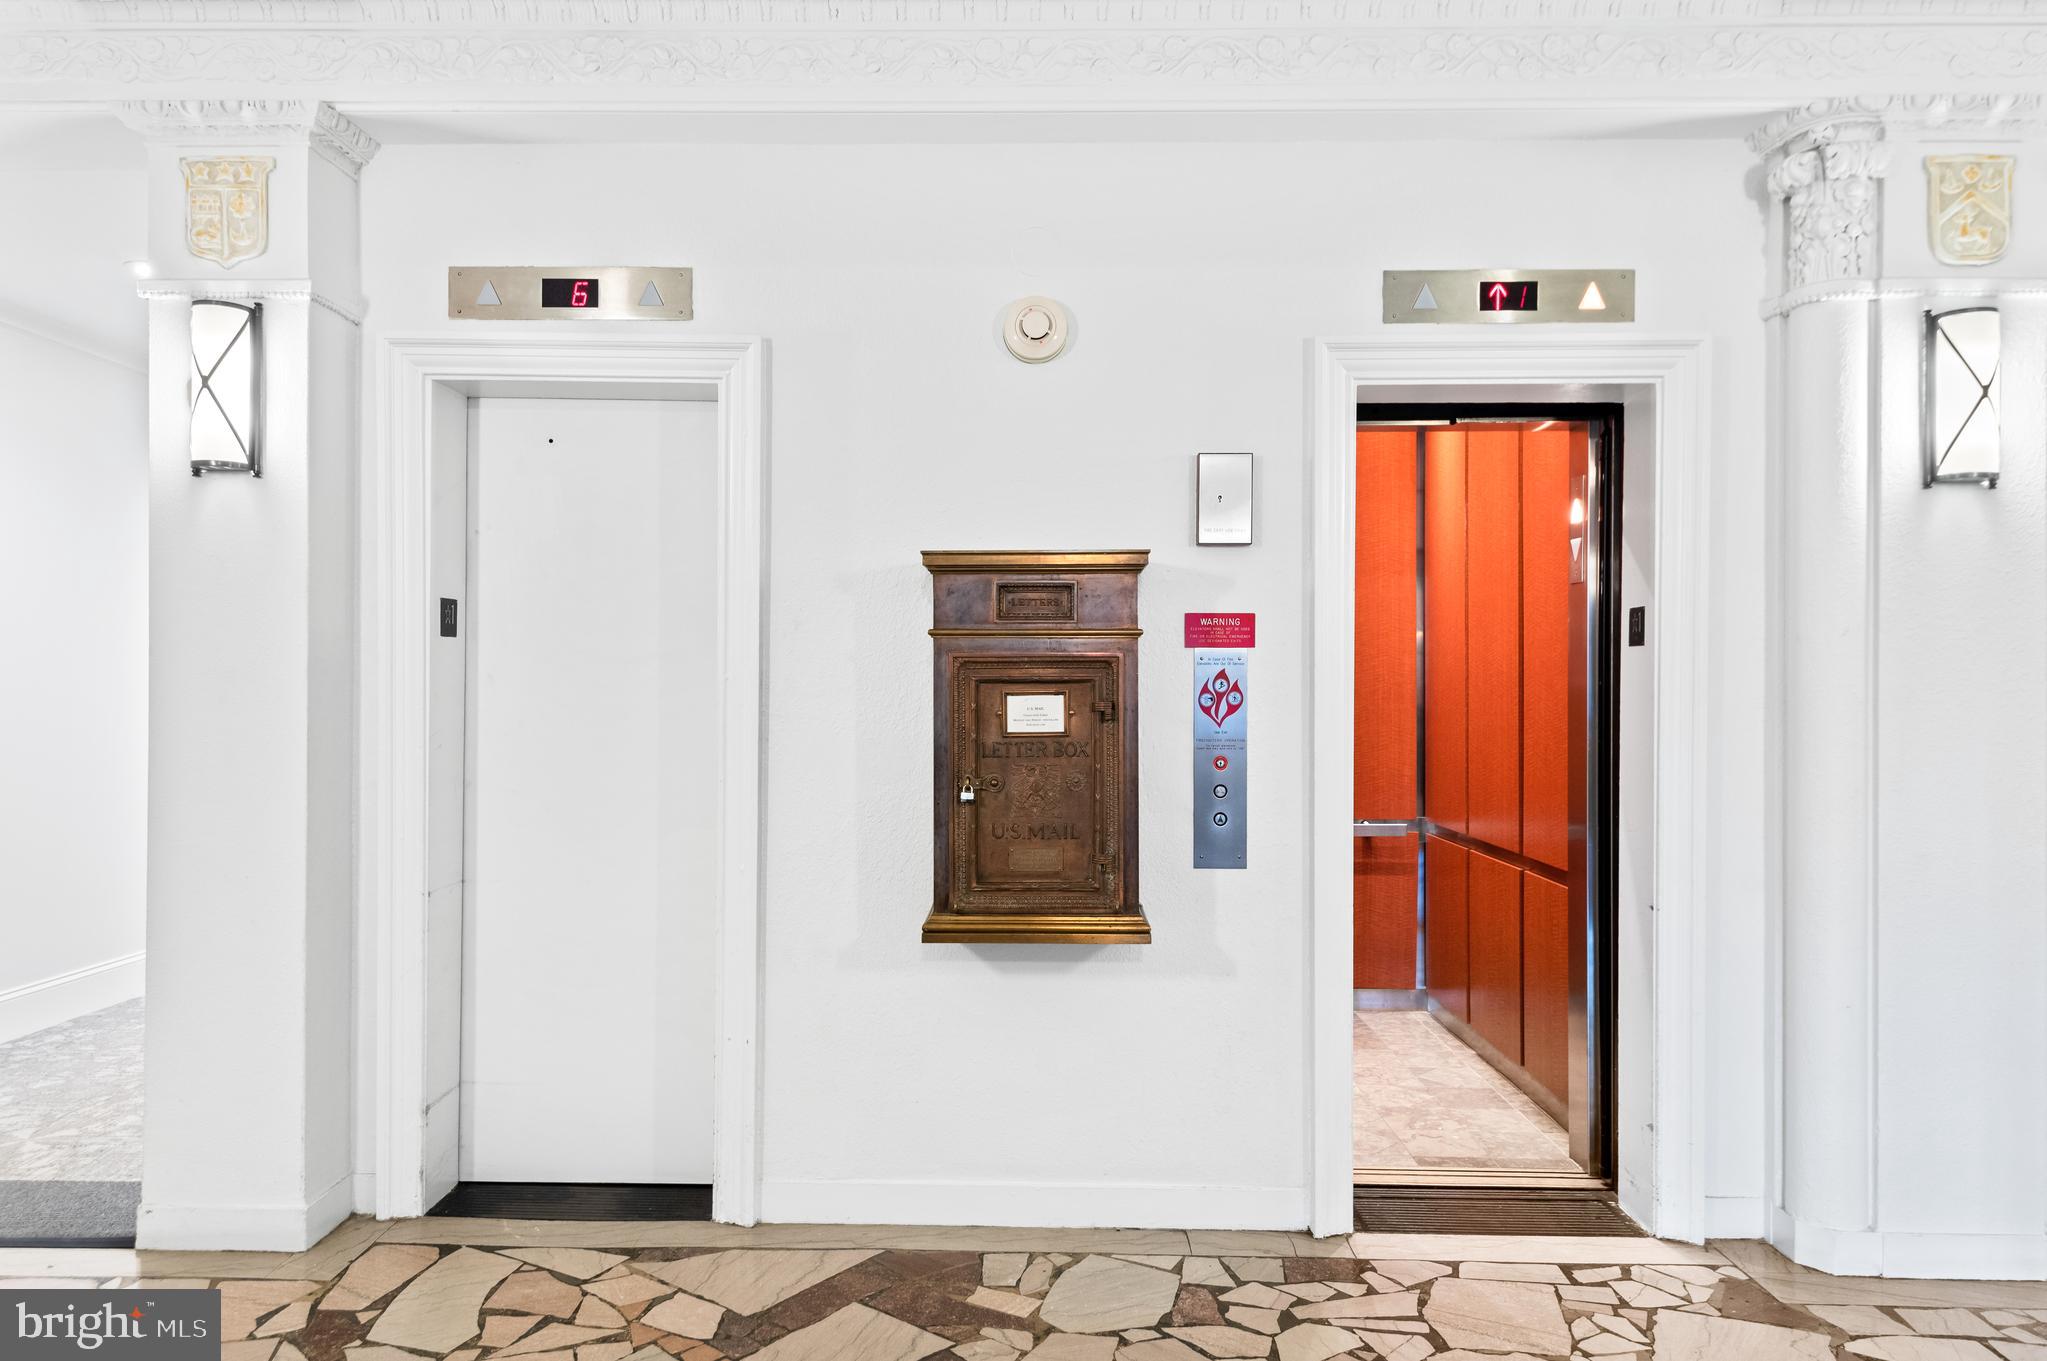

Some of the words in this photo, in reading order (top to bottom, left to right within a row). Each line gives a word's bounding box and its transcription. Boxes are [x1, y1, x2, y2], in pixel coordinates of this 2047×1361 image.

[572, 281, 588, 306] 6
[1010, 598, 1060, 607] LETTERS
[1200, 617, 1241, 626] WARNING
[981, 741, 1048, 759] LETTER
[1053, 741, 1089, 758] BOX
